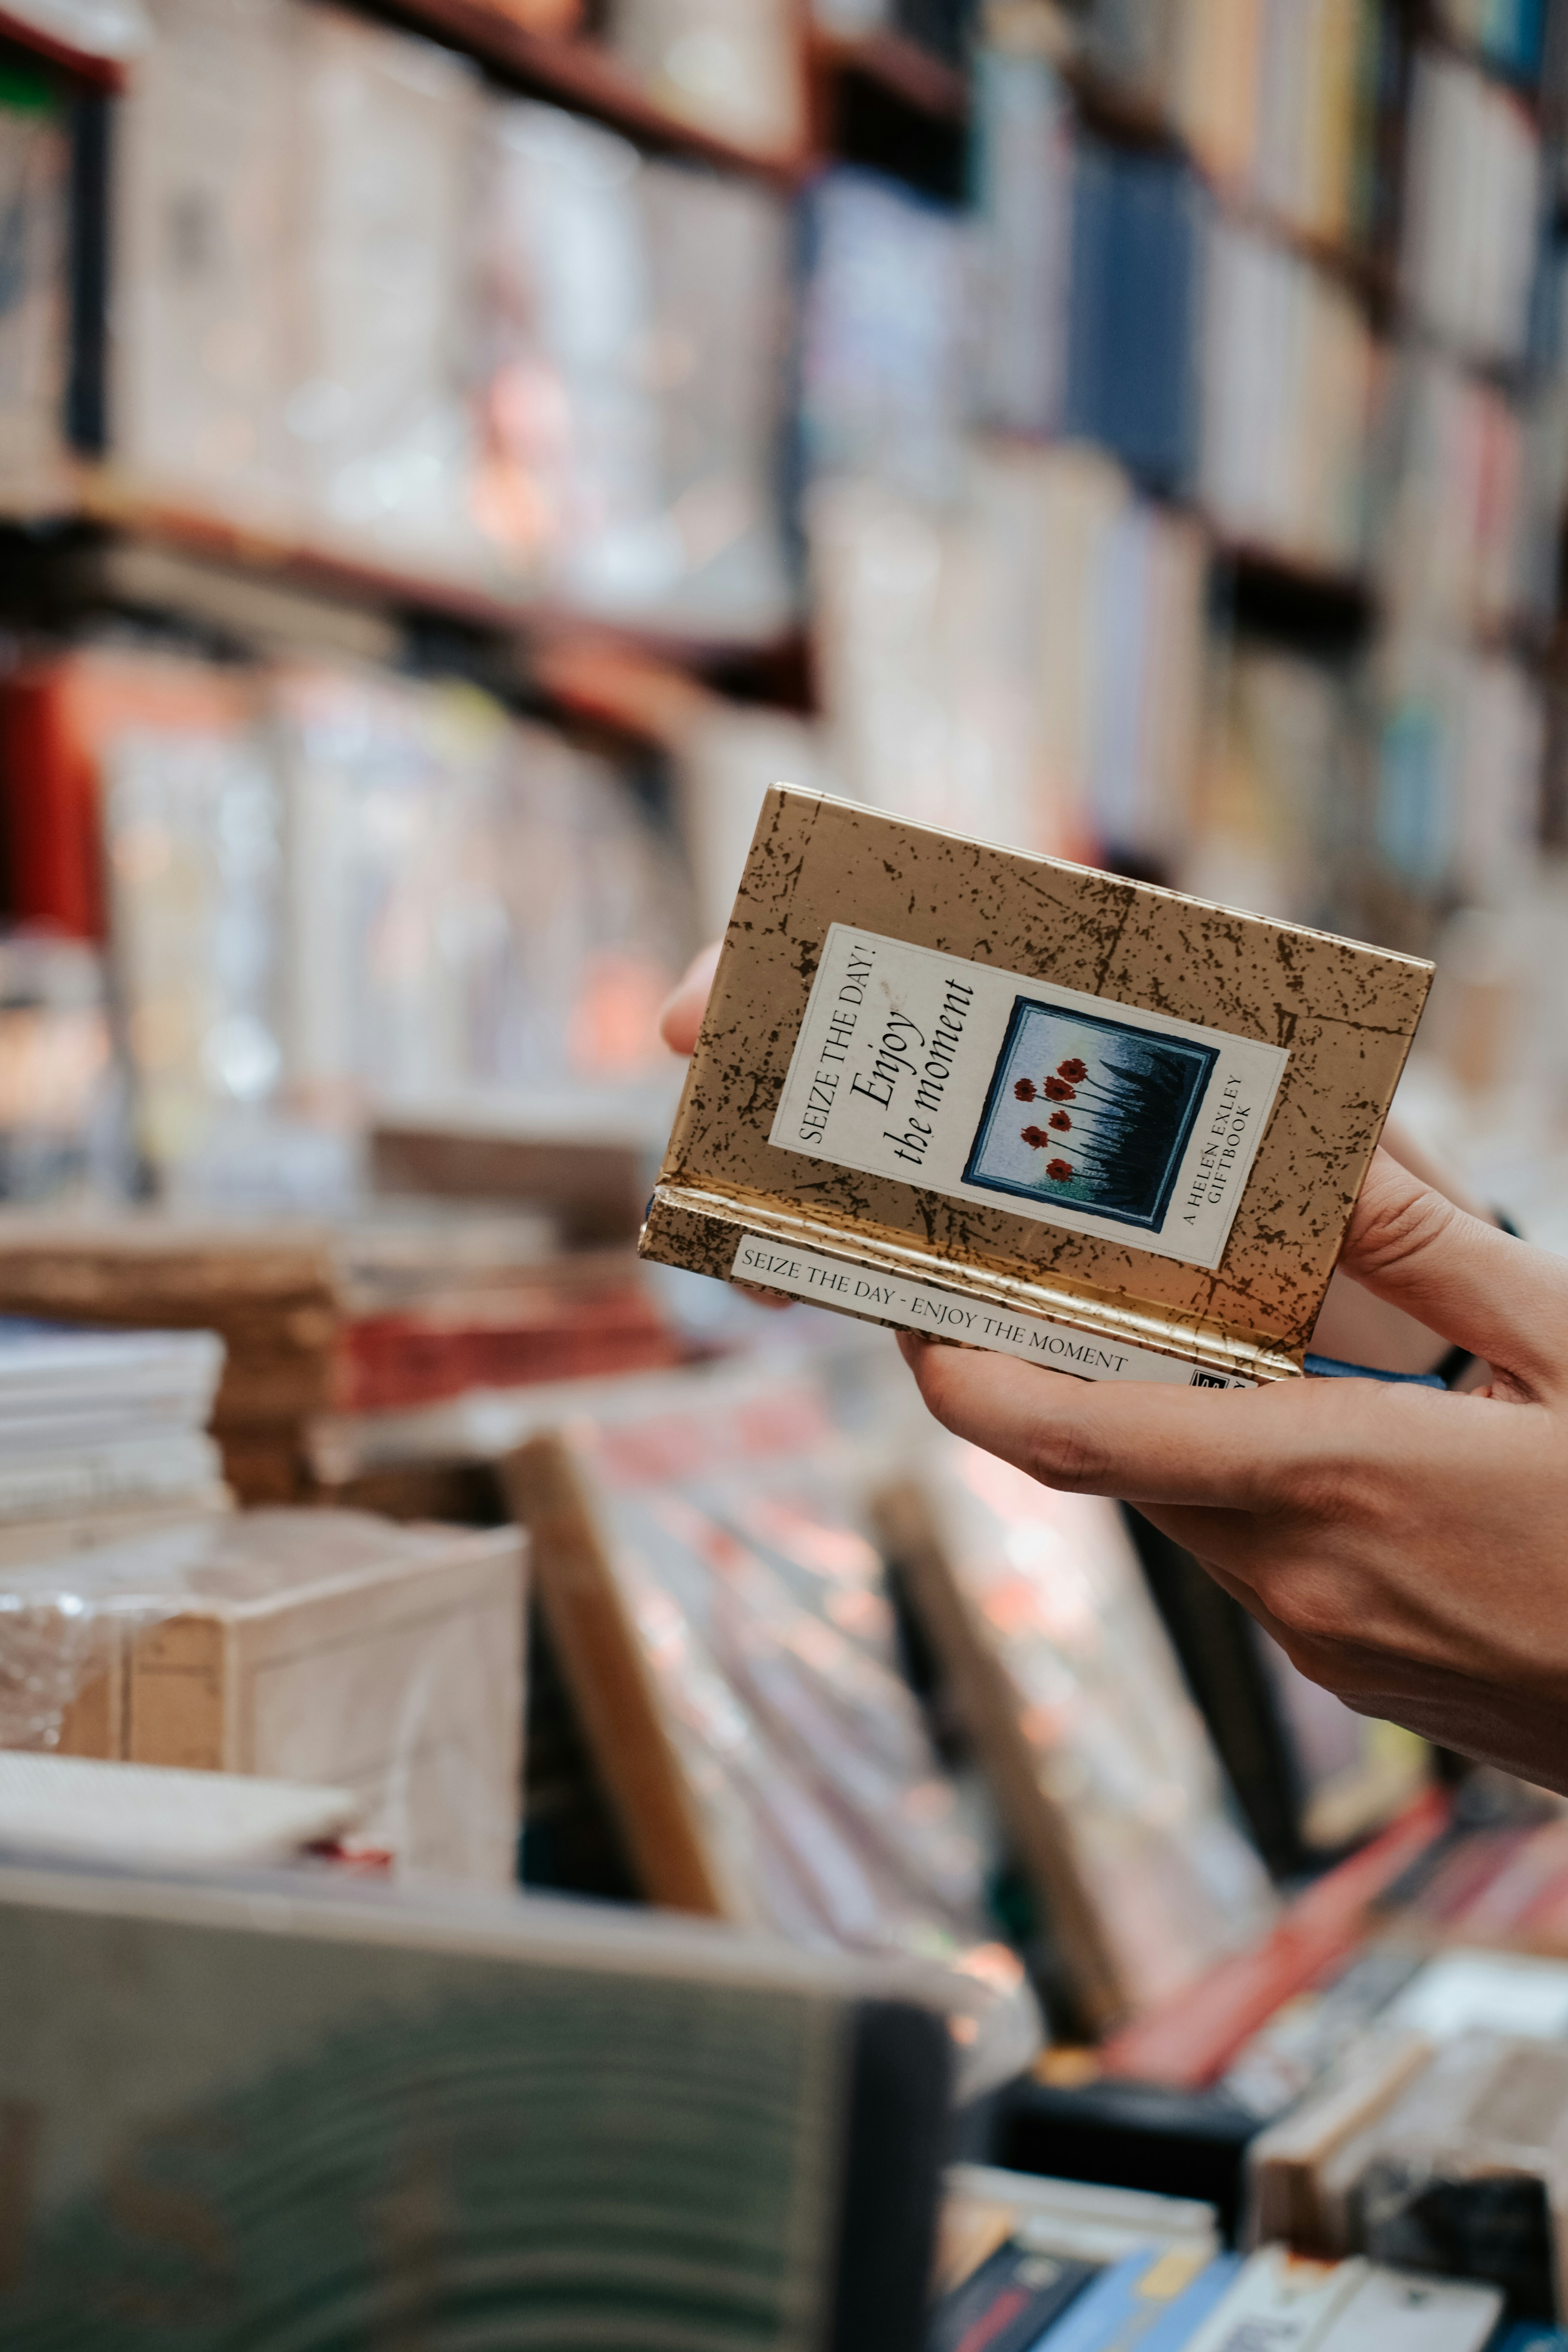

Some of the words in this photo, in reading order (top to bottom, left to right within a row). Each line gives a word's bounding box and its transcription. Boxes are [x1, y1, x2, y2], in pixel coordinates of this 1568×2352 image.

[799, 1070, 839, 1144] SEIZE
[820, 1010, 857, 1063] THE
[839, 945, 876, 1006] DAY!
[850, 1011, 925, 1111] Enjoy
[883, 1117, 932, 1165] the
[914, 979, 974, 1112] moment
[1208, 1106, 1251, 1204] GIFTBOOK
[1211, 1075, 1242, 1136] EXLEY
[1183, 1215, 1196, 1226] A
[1188, 1142, 1219, 1207] HELEN
[742, 1250, 802, 1279] SEIZE
[807, 1266, 851, 1292] THE
[854, 1281, 896, 1305] DAY
[911, 1297, 978, 1325] ENJOY
[983, 1317, 1026, 1343] THE
[1029, 1332, 1129, 1372] MOMENT
